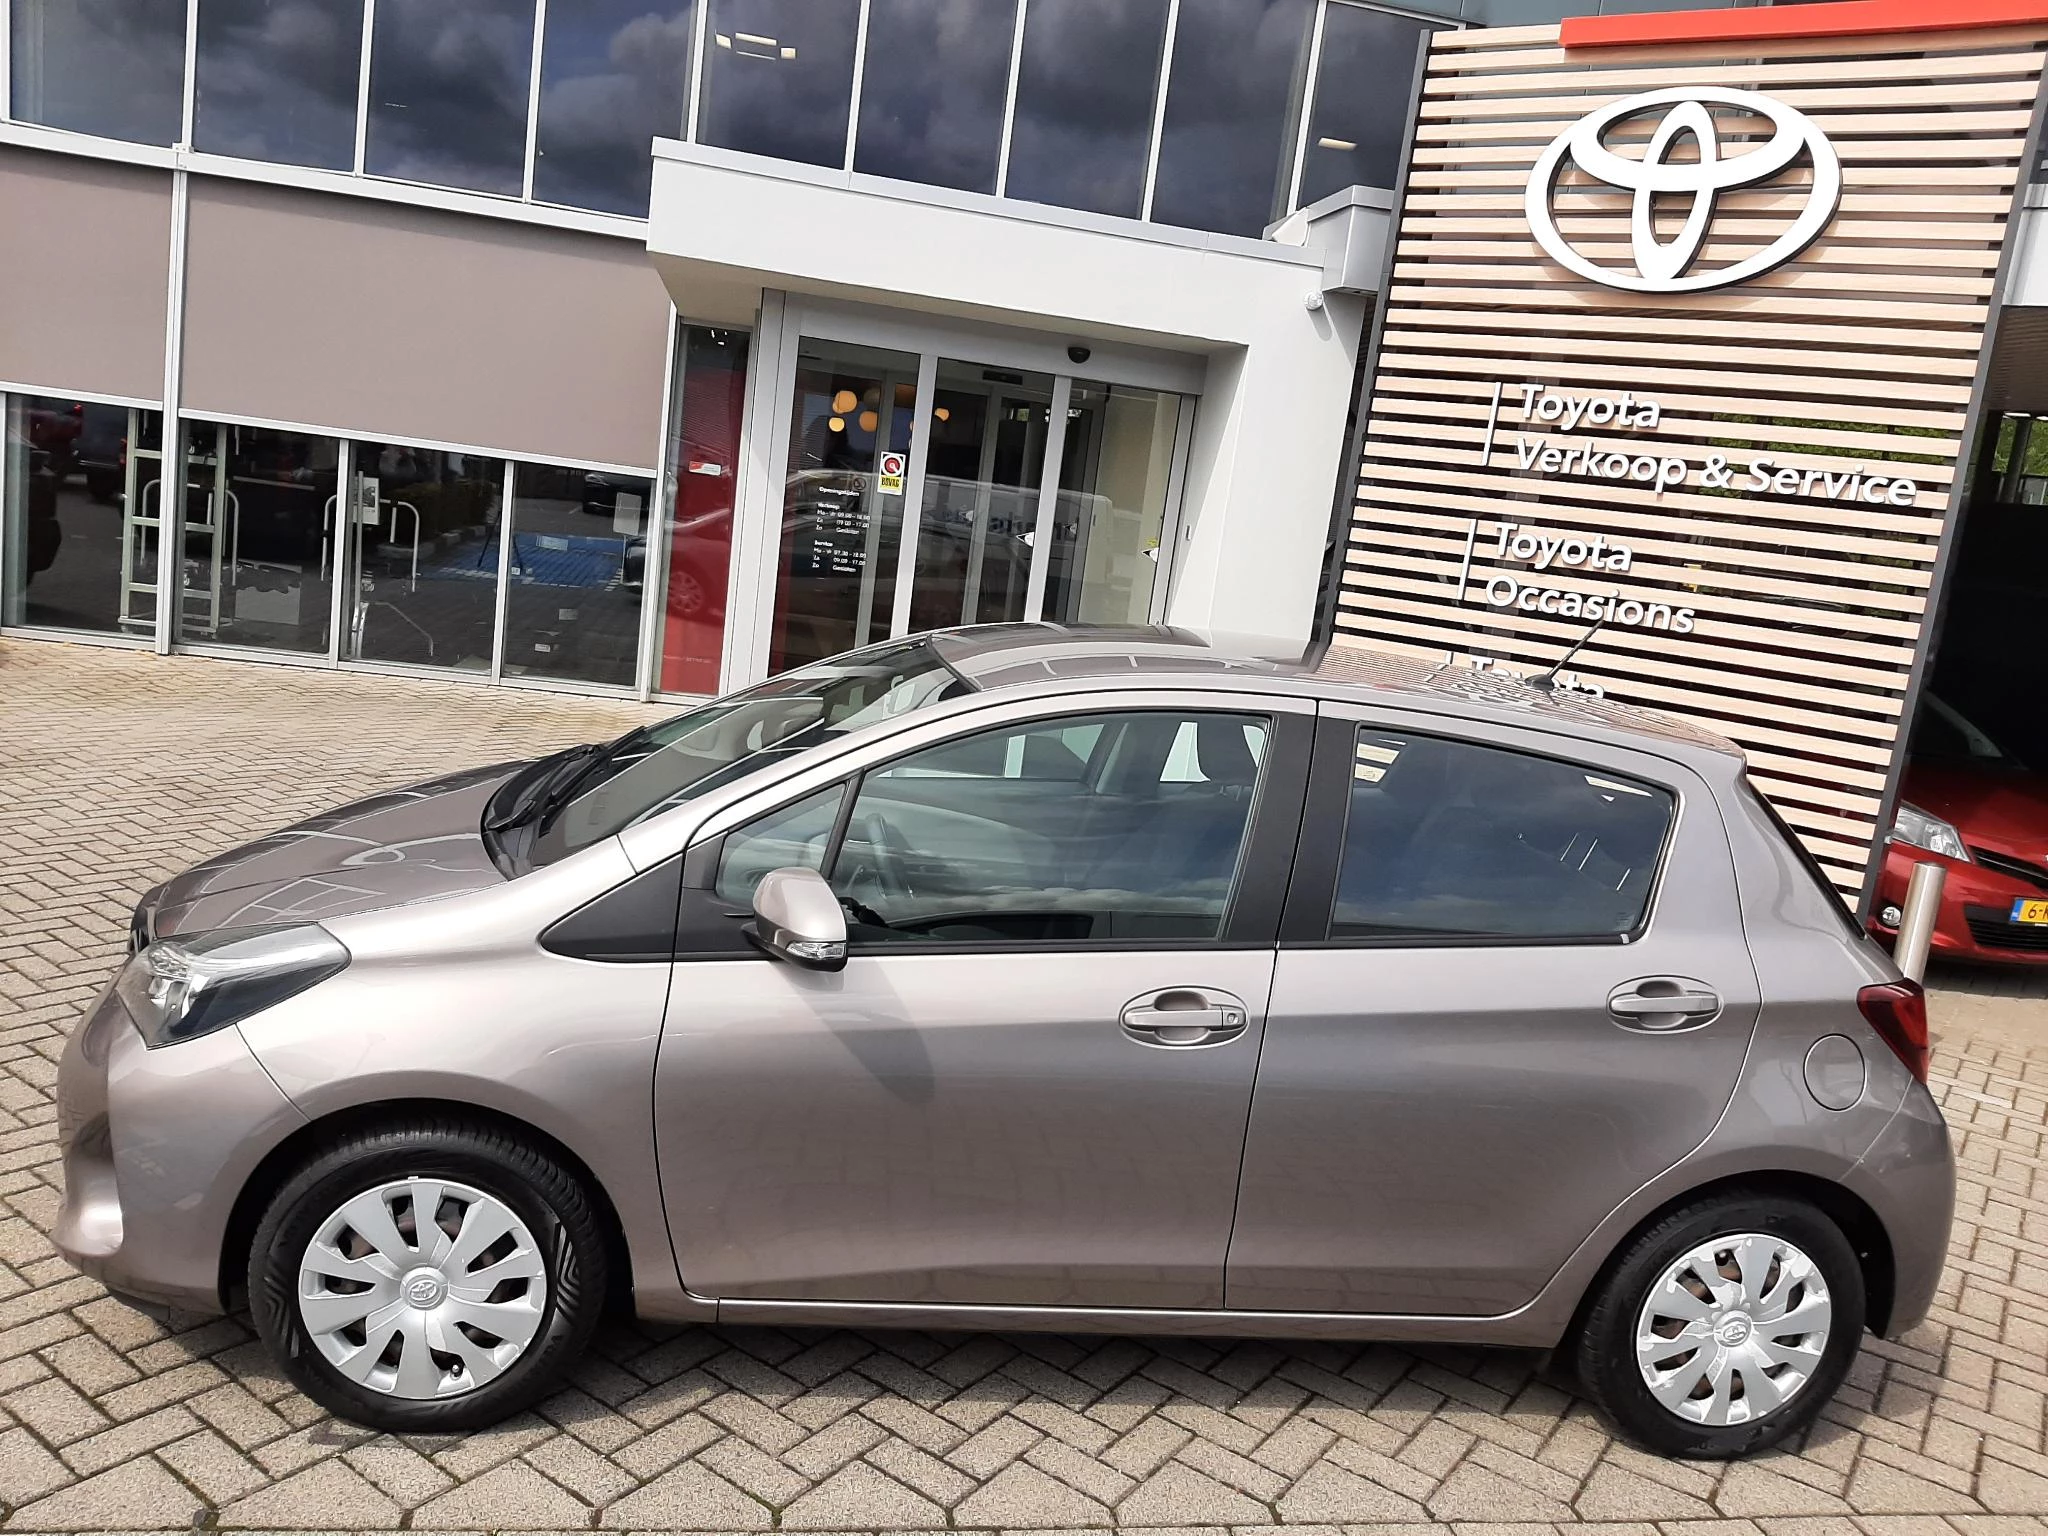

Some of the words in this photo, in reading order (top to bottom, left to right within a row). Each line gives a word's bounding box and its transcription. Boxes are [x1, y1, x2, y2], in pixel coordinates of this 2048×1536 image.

[1520, 383, 1660, 431] Toyota
[1516, 437, 1687, 494] Verkoop
[1699, 453, 1733, 489] &
[1745, 456, 1917, 507] Service
[1494, 522, 1633, 571] Toyota
[1485, 575, 1696, 634] Occasions
